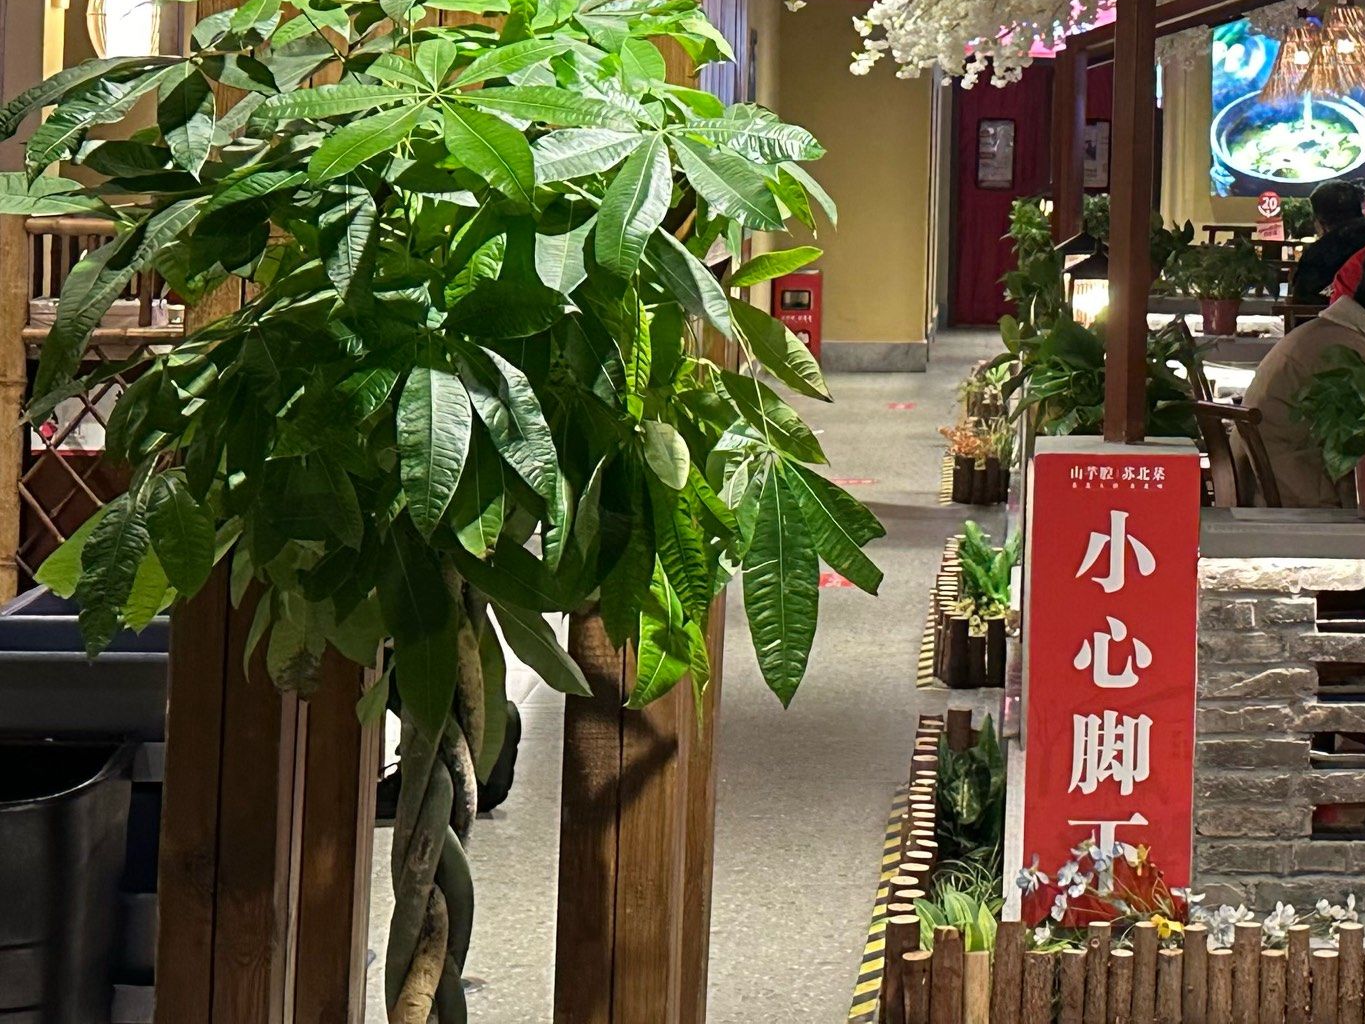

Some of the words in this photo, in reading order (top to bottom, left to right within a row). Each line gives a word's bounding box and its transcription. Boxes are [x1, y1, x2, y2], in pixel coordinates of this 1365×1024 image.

[1261, 196, 1278, 211] 20
[1067, 509, 1158, 892] 小心脚下
